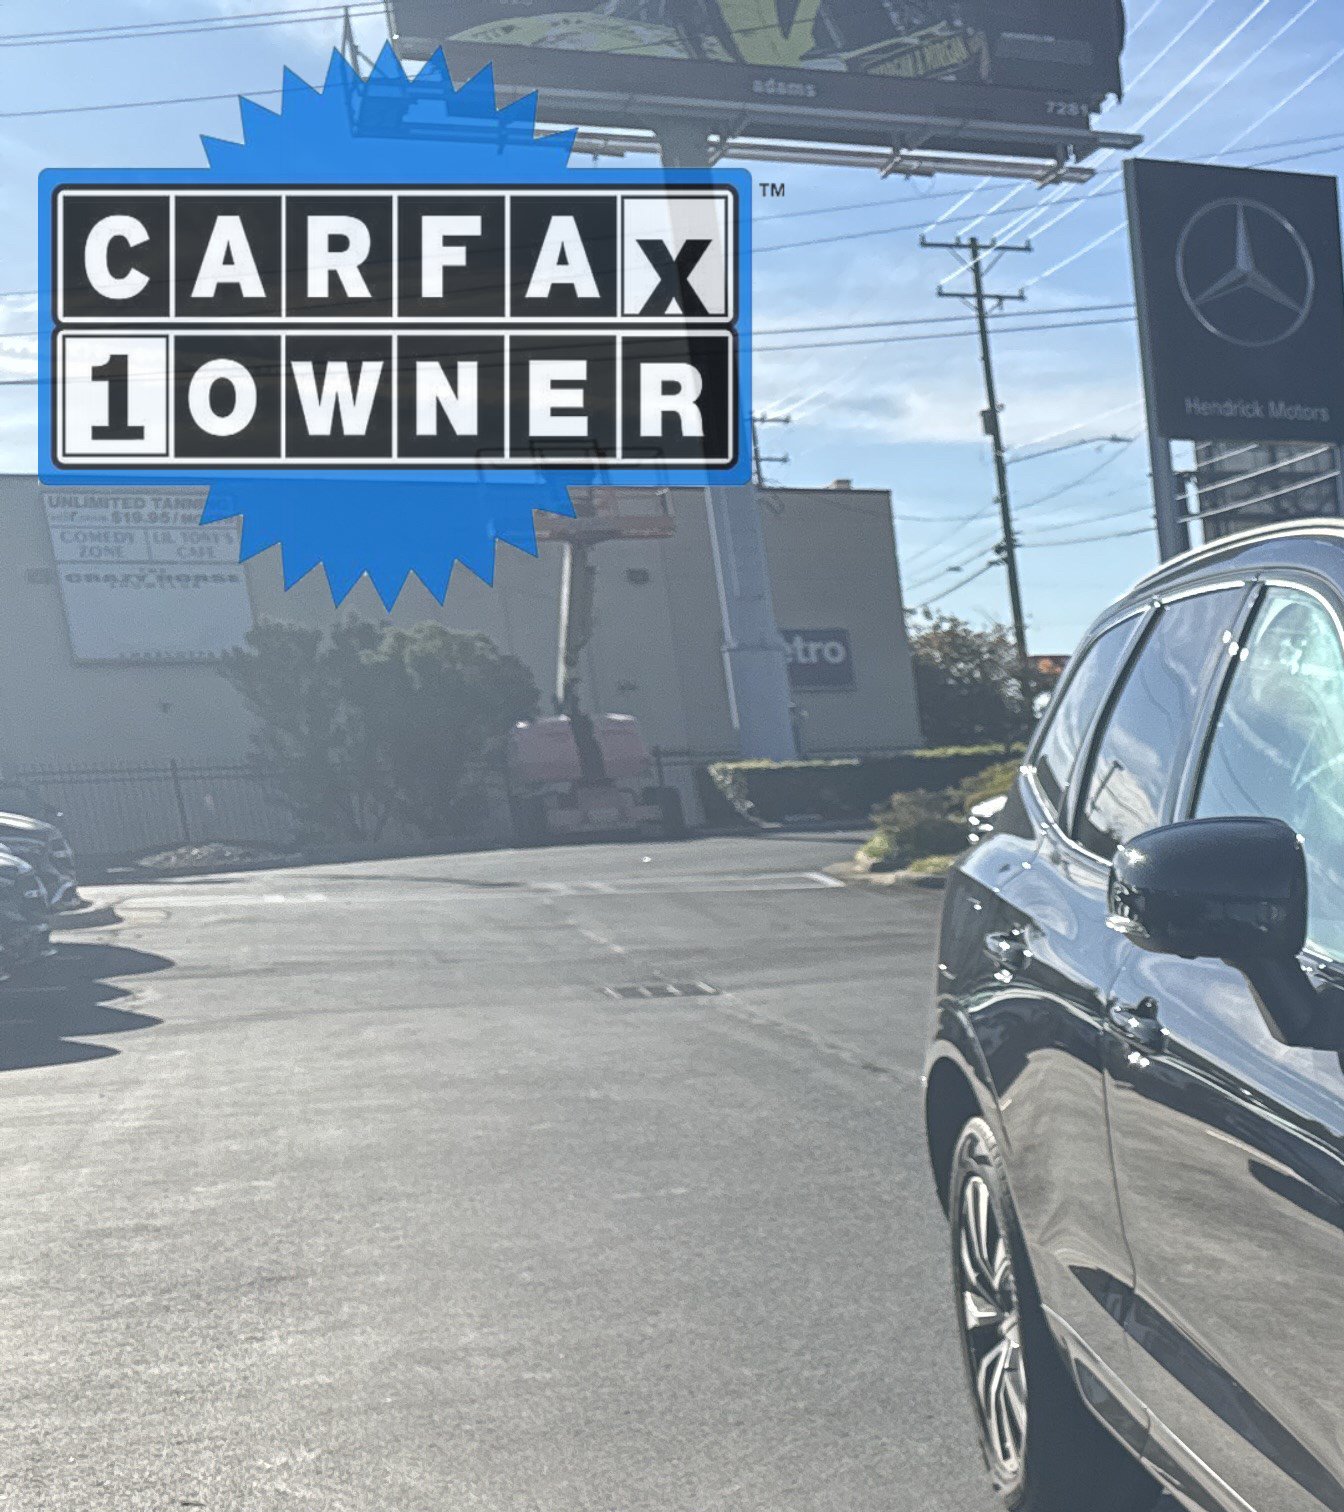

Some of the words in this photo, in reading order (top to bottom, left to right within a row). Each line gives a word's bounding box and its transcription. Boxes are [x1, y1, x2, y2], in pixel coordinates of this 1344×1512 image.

[751, 78, 817, 98] adams
[1184, 396, 1265, 419] Hendrick
[1267, 399, 1331, 423] Motors
[49, 496, 147, 509] UNLIMITED
[60, 531, 135, 543] COMEDY
[78, 545, 124, 558] ZONE
[784, 634, 847, 665] etro
